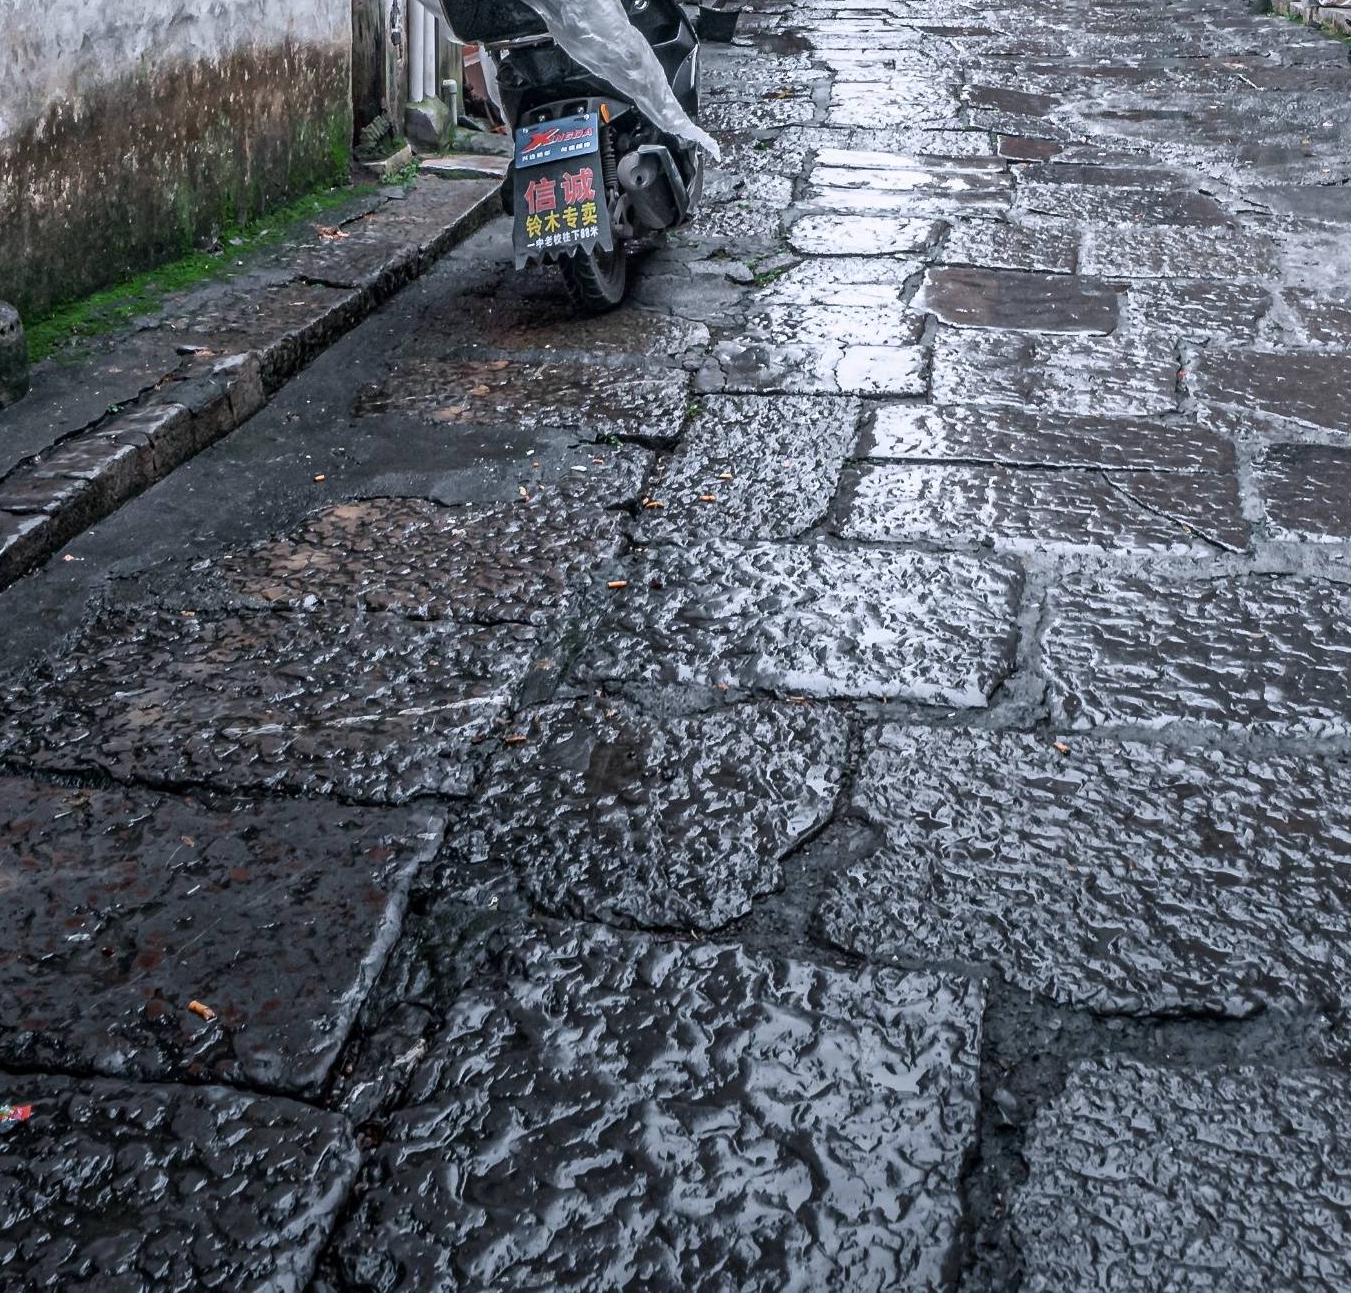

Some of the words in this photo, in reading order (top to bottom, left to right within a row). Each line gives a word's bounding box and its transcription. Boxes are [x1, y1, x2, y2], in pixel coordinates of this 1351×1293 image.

[523, 167, 596, 215] 信诚
[525, 202, 598, 238] 铃木专卖
